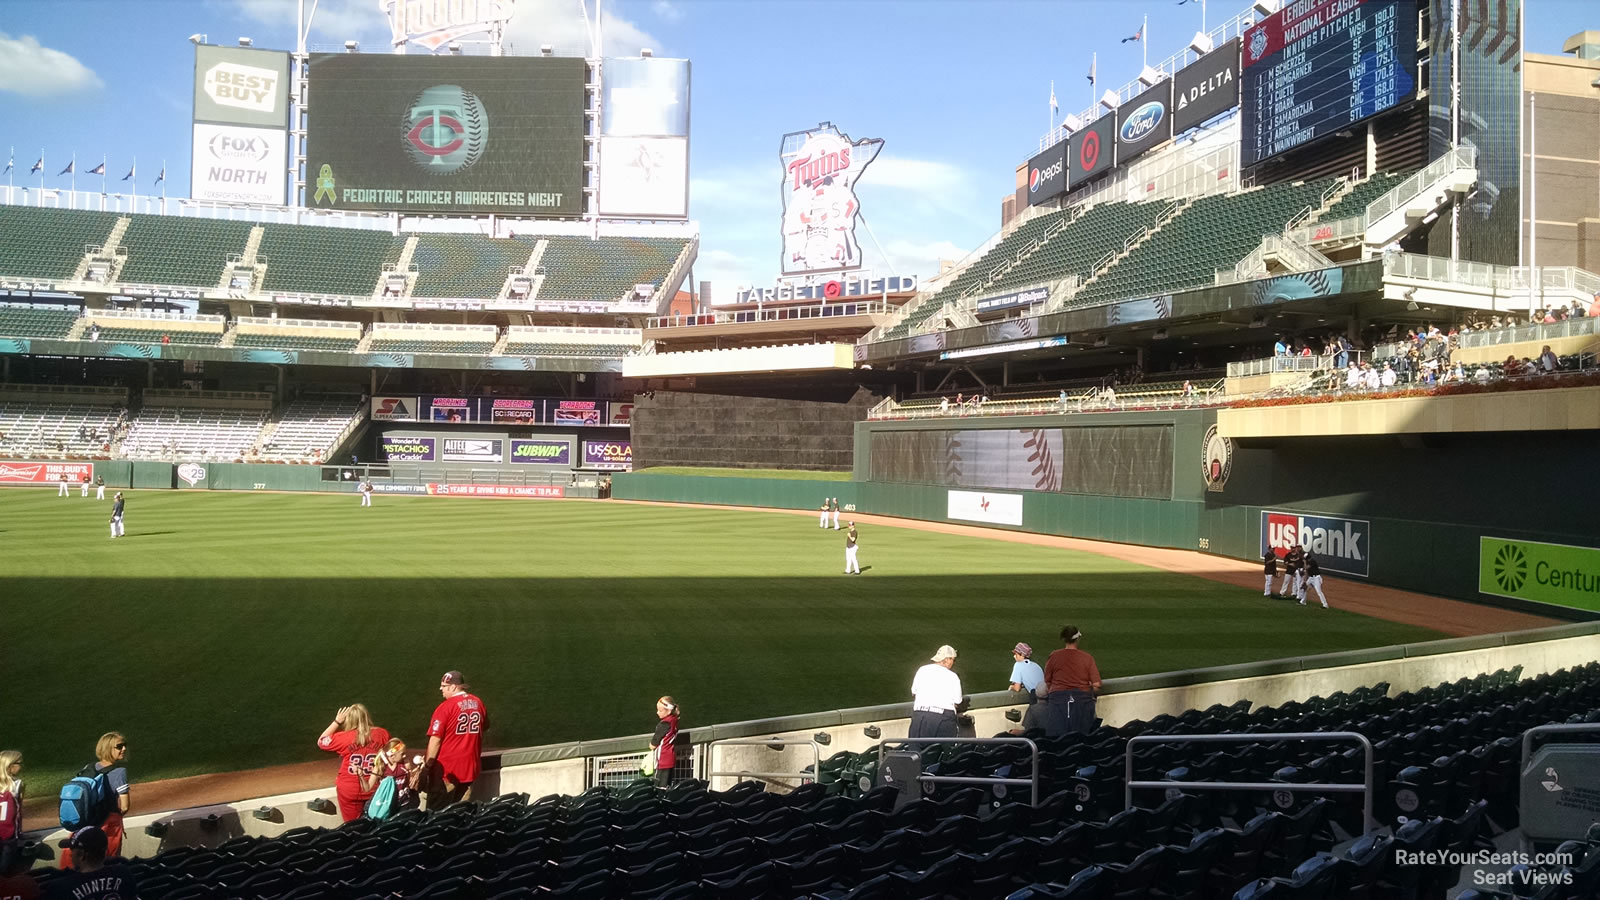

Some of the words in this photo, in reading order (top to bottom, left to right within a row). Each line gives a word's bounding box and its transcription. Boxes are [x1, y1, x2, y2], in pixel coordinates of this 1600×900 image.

[1283, 31, 1318, 60] INNINGS
[1320, 8, 1360, 40] PITCHED
[1284, 12, 1324, 44] NATIONAL
[1259, 74, 1262, 84] 1
[1268, 68, 1274, 80] M
[1275, 54, 1306, 77] SCHERZER
[1349, 20, 1366, 38] WSH
[1375, 6, 1394, 25] 190.0
[1259, 87, 1262, 97] 2
[1268, 81, 1273, 92] M
[1275, 62, 1312, 89] BUMGARNER
[1353, 36, 1362, 50] SF
[1375, 20, 1394, 39] 187.2
[216, 70, 275, 90] BEST
[1190, 67, 1233, 102] DELTA
[1258, 99, 1262, 110] 3
[1269, 94, 1272, 104] J
[1275, 84, 1294, 101] CUETO
[1353, 50, 1362, 64] SF
[1376, 35, 1394, 53] 184.1
[1258, 112, 1262, 121] 4
[1268, 106, 1273, 117] T
[1275, 96, 1295, 114] ROARK
[1349, 62, 1366, 80] WSH
[1376, 49, 1393, 67] 175.1
[216, 84, 268, 103] BUY
[1258, 124, 1262, 134] 5
[1268, 119, 1272, 130] J
[1275, 101, 1314, 127] SAMARDZIJA
[1353, 78, 1362, 92] SF
[1375, 64, 1394, 82] 170.2
[1128, 112, 1154, 138] Ford
[1258, 137, 1262, 147] 6
[1268, 132, 1272, 142] J
[1275, 120, 1299, 140] ARRIETA
[1350, 92, 1364, 108] CHC
[1375, 79, 1394, 97] 168.0
[1258, 149, 1261, 160] 7
[1268, 145, 1272, 156] A
[1275, 126, 1315, 152] WAINWRIGHT
[1350, 107, 1364, 121] STL
[1375, 93, 1394, 112] 163.0
[222, 136, 256, 152] FOX
[208, 167, 267, 184] NORTH
[788, 148, 850, 191] Twins
[1040, 157, 1062, 186] pepsi
[343, 189, 403, 203] PEDIATRIC
[406, 190, 451, 204] CANCER
[455, 191, 524, 206] AWARENESS
[528, 193, 562, 207] NIGHT
[736, 282, 822, 303] TARGET
[844, 275, 917, 296] FIELD
[383, 445, 429, 453] PISTACHIOS
[514, 445, 567, 457] SUBWAY
[191, 469, 204, 478] 29
[437, 485, 448, 494] 25
[515, 487, 536, 495] CHANCE
[844, 504, 856, 512] 403
[1199, 537, 1209, 549] 365
[456, 712, 480, 734] 22
[72, 878, 122, 900] HUNTER
